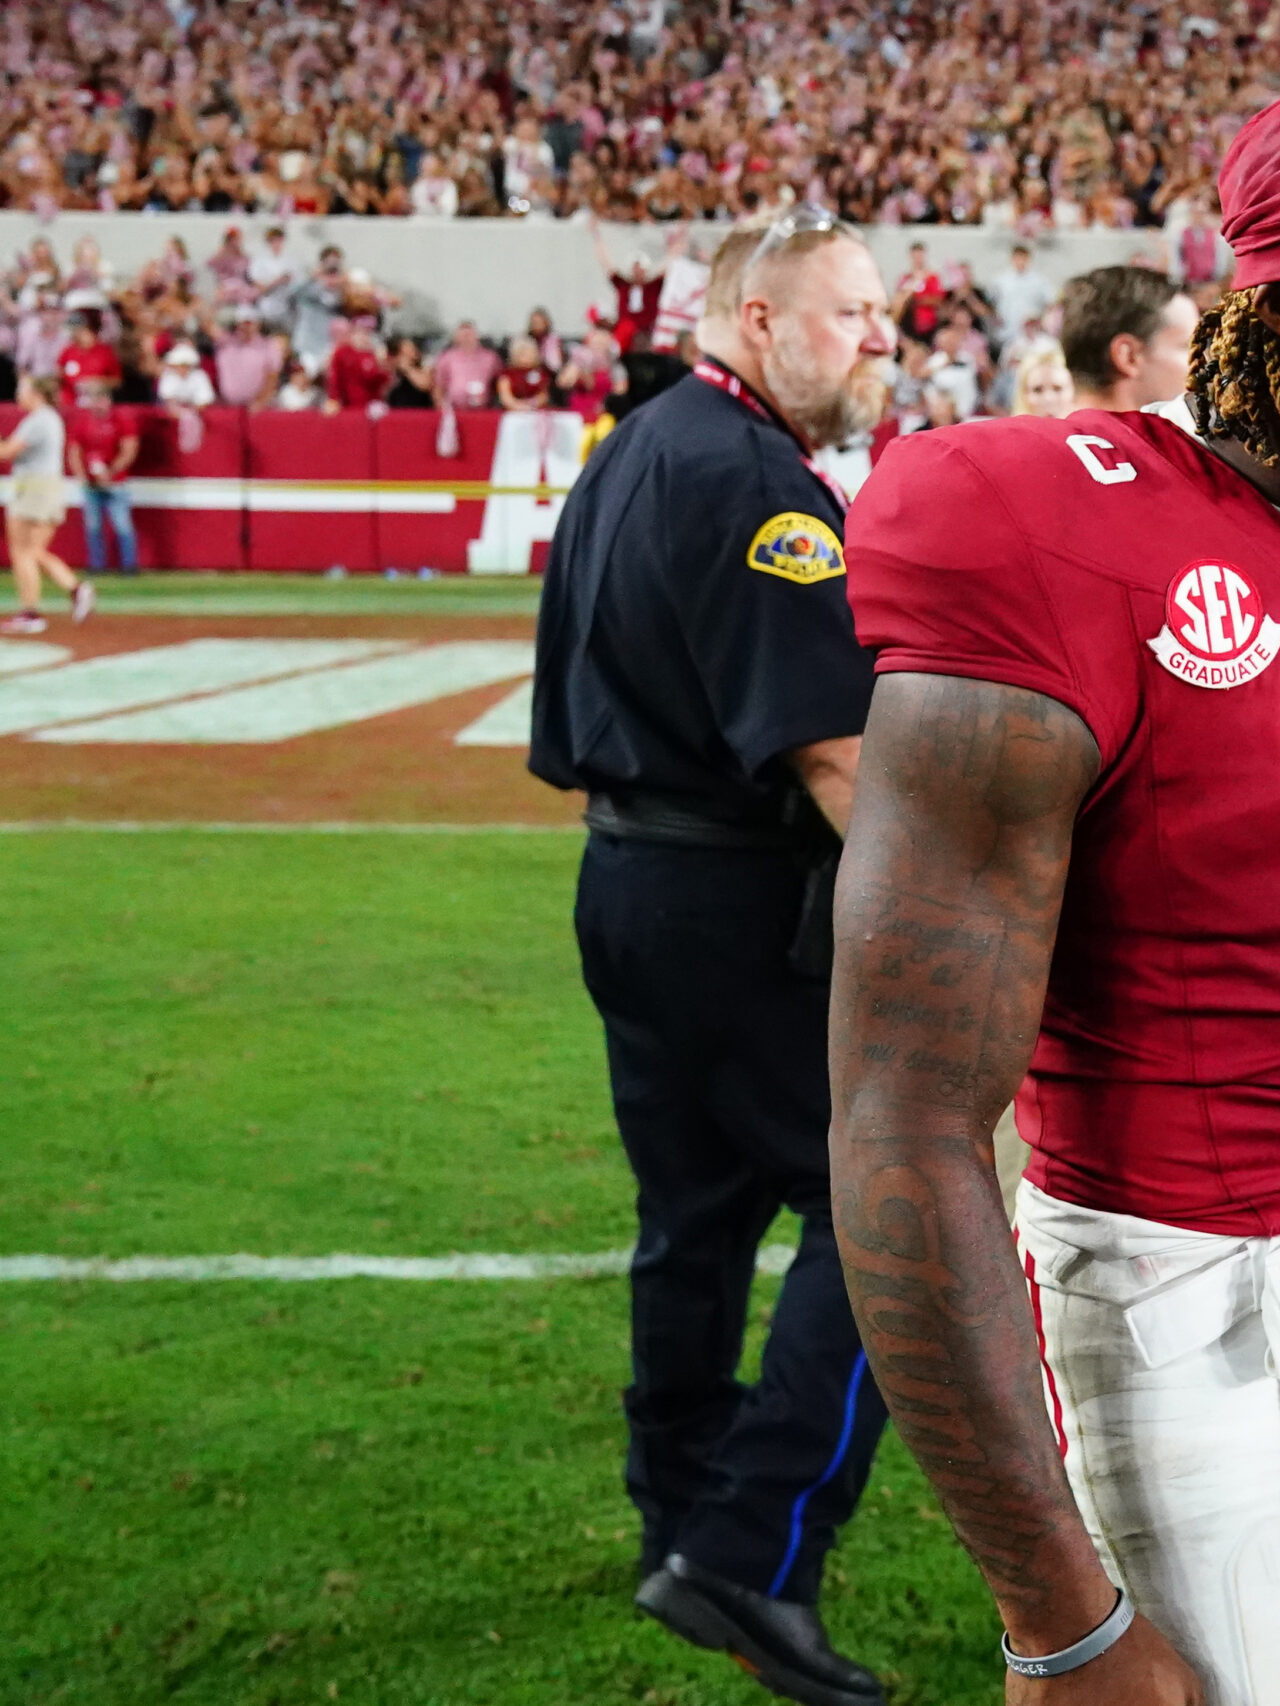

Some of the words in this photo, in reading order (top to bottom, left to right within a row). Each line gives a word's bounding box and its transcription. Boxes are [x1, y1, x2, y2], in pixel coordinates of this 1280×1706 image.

[1065, 434, 1138, 485] C
[1174, 565, 1255, 654] SEC
[1169, 643, 1271, 685] GRADUATE
